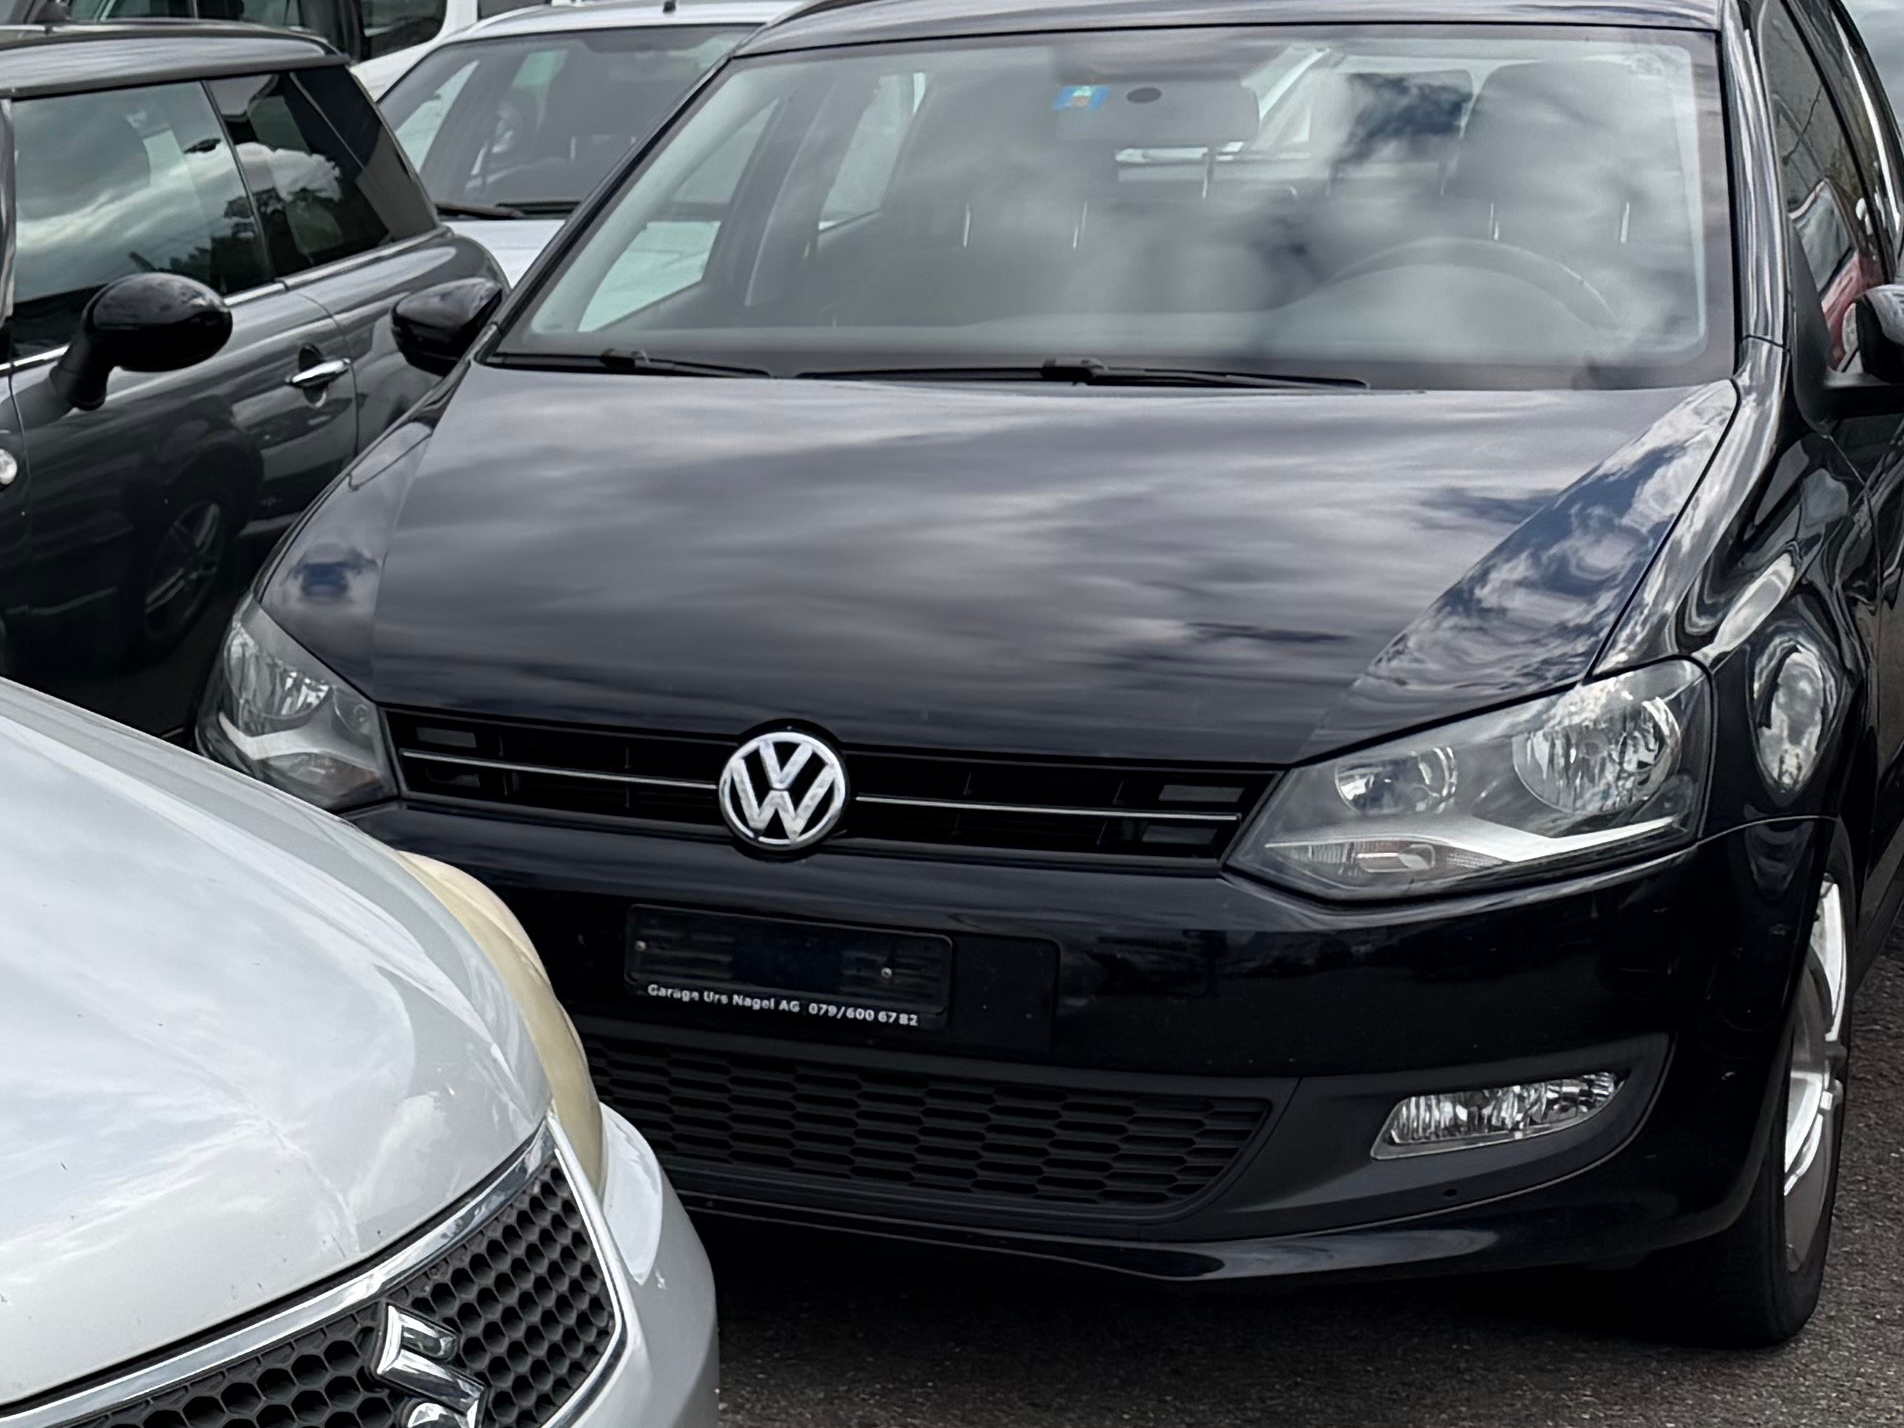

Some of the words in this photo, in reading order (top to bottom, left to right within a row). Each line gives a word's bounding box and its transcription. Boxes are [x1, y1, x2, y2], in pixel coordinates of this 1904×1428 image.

[647, 983, 700, 1003] Garage
[703, 990, 729, 1004] Urs
[732, 994, 775, 1011] Nagel
[778, 999, 801, 1013] AG
